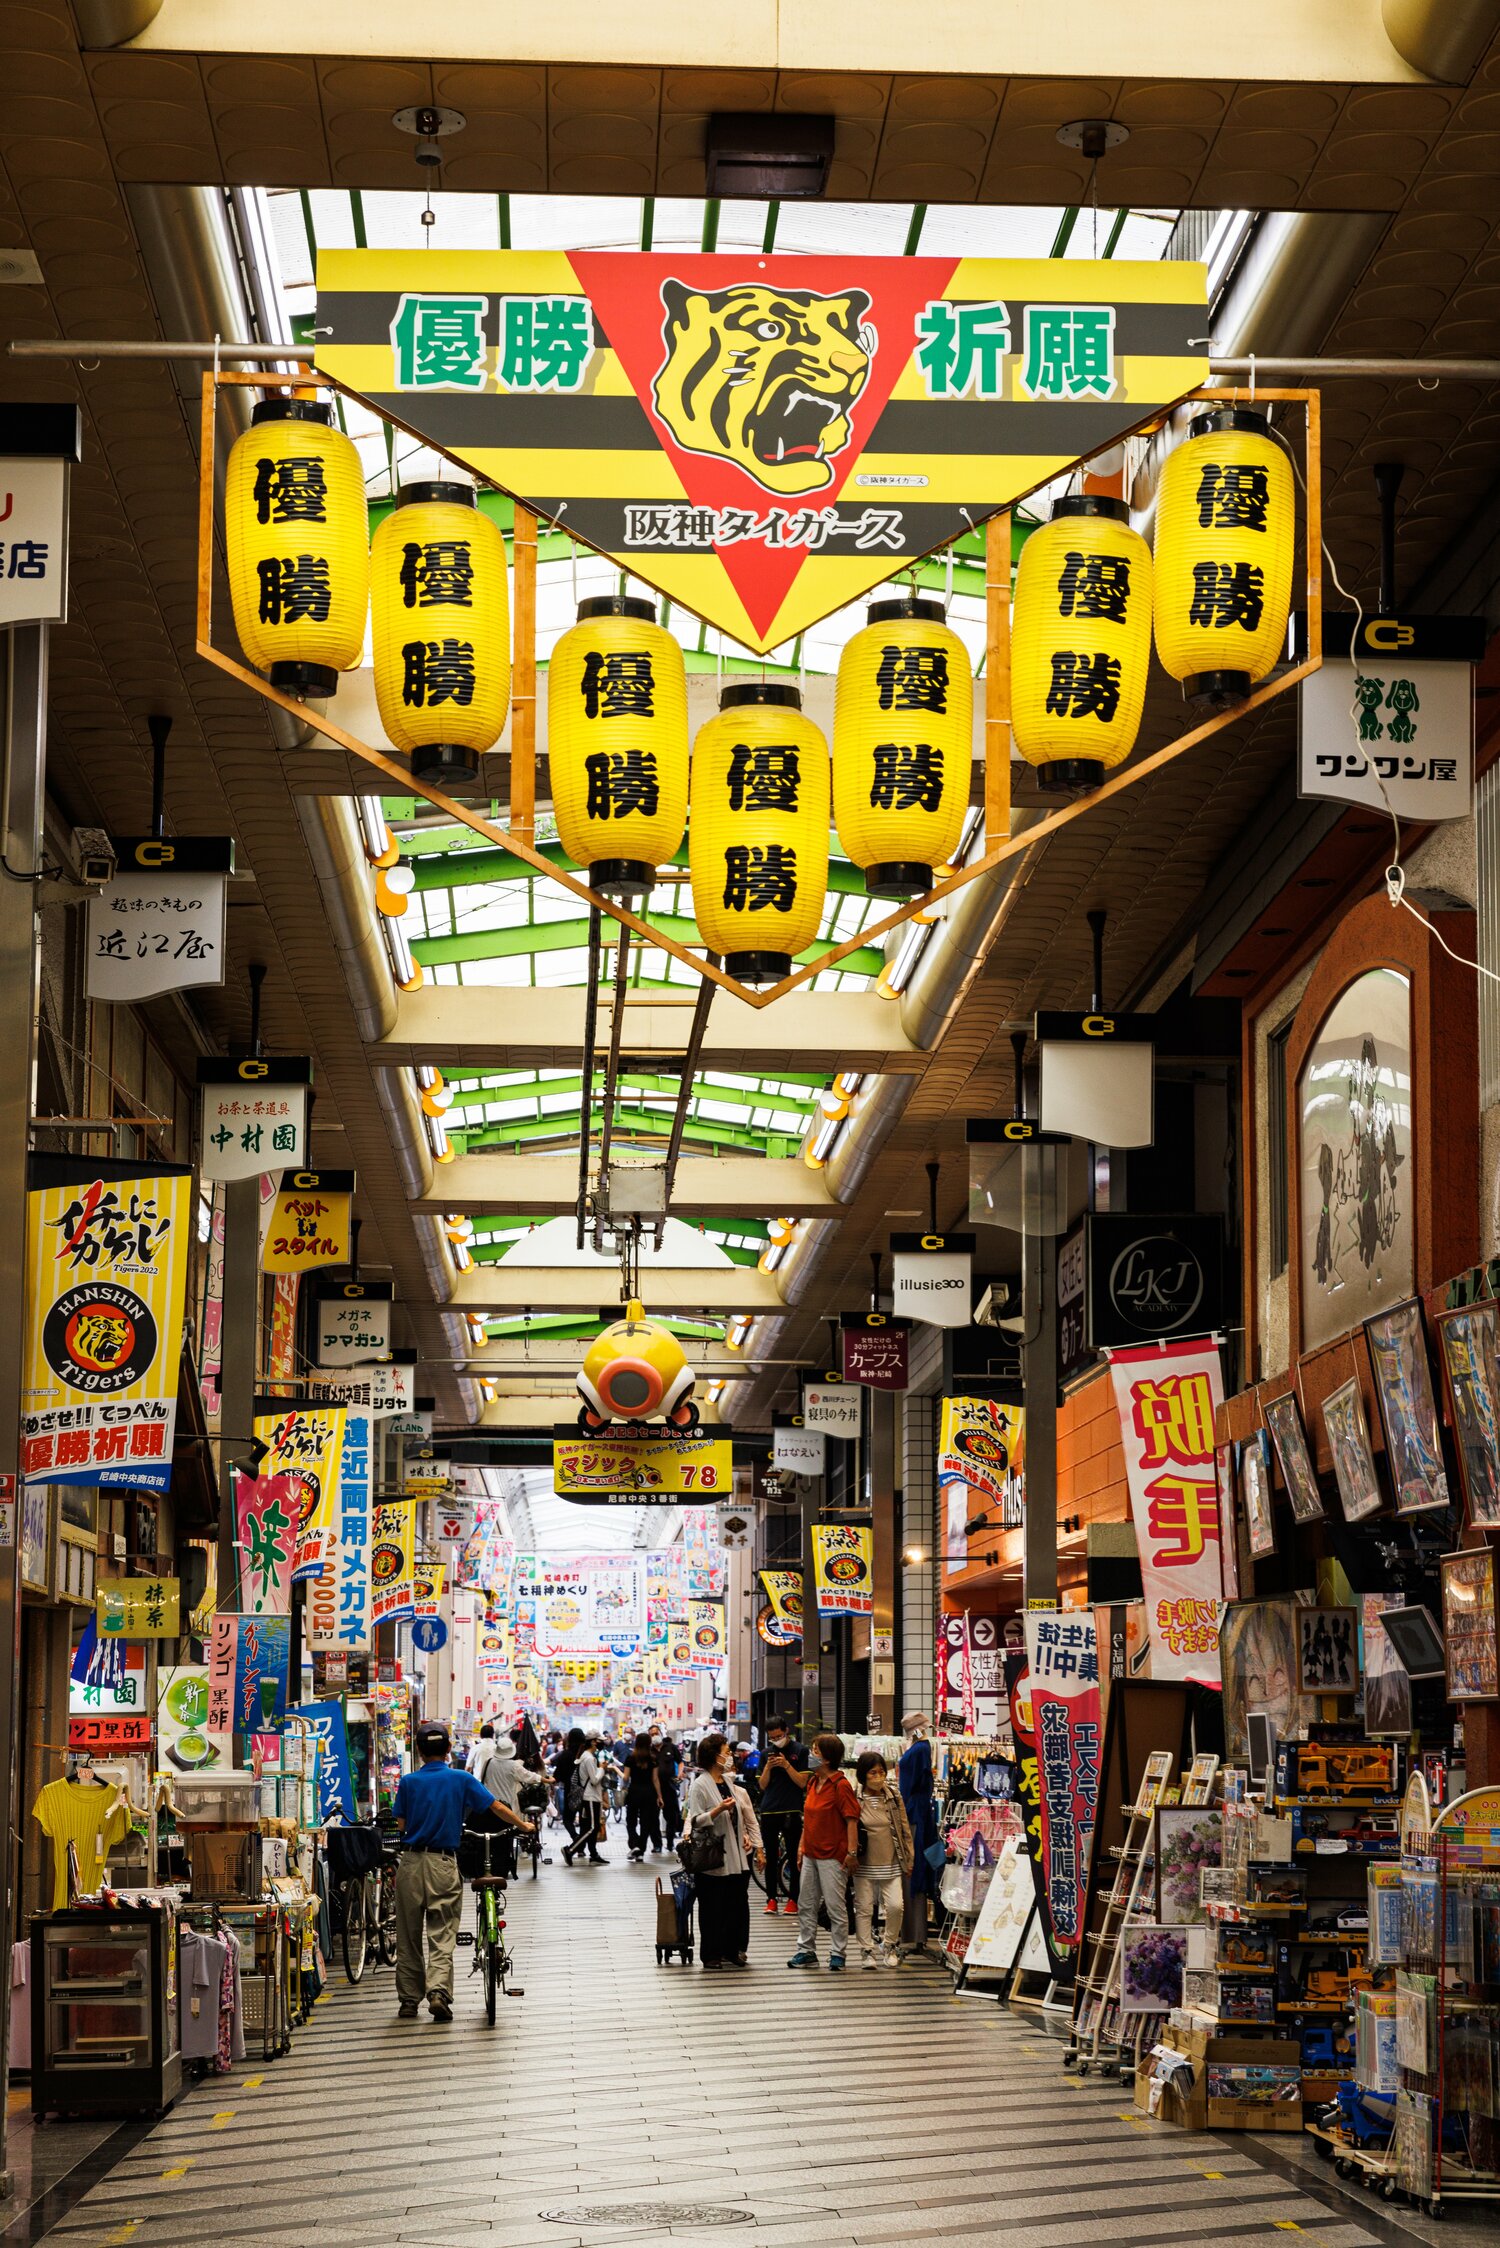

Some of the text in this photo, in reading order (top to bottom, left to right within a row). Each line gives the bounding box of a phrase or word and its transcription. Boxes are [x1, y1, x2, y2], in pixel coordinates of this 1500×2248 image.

[392, 293, 1117, 400] 優勝 祈願
[253, 455, 330, 625] 優勝
[624, 505, 905, 551] 阪神タイガース
[0, 540, 48, 579] 店
[1189, 462, 1270, 633] 優勝
[400, 540, 475, 708] 優勝
[1046, 551, 1131, 723] 優勝
[581, 650, 659, 820] 優勝
[870, 644, 950, 814] 優勝
[1316, 754, 1457, 782] ワンワン屋
[722, 743, 801, 913] 優勝
[110, 897, 203, 913] 趣味のきもの
[96, 928, 215, 961] 近江屋
[217, 1101, 291, 1116] お茶と茶道具
[209, 1123, 297, 1154] 中村園
[284, 1199, 329, 1217] ペット
[273, 1237, 339, 1256] スタイル
[113, 1264, 158, 1274] Tigers 2022
[56, 1287, 145, 1319] HANSHIN
[336, 1310, 372, 1322] メガネ
[323, 1334, 384, 1347] アマガン
[349, 1323, 359, 1331] の
[895, 1331, 905, 1339] 2F
[58, 1359, 137, 1390] Tigers
[849, 1352, 903, 1368] カーブス
[99, 1401, 167, 1422] てっぺん
[808, 1408, 858, 1422] 寝具の今井
[25, 1423, 165, 1475] 優勝祈願
[561, 1452, 637, 1474] マジック
[777, 1448, 821, 1458] はなえい
[98, 1471, 166, 1487] 尼崎中央商店街
[680, 1465, 718, 1488] 78
[339, 1417, 369, 1645] 遠近両用メガネ
[145, 1583, 166, 1629] 抹茶
[313, 1631, 334, 1640] ヨリ
[209, 1623, 234, 1731] リンゴ 黒酢
[243, 1621, 261, 1721] グリーンティー
[179, 1679, 205, 1722] 新茶
